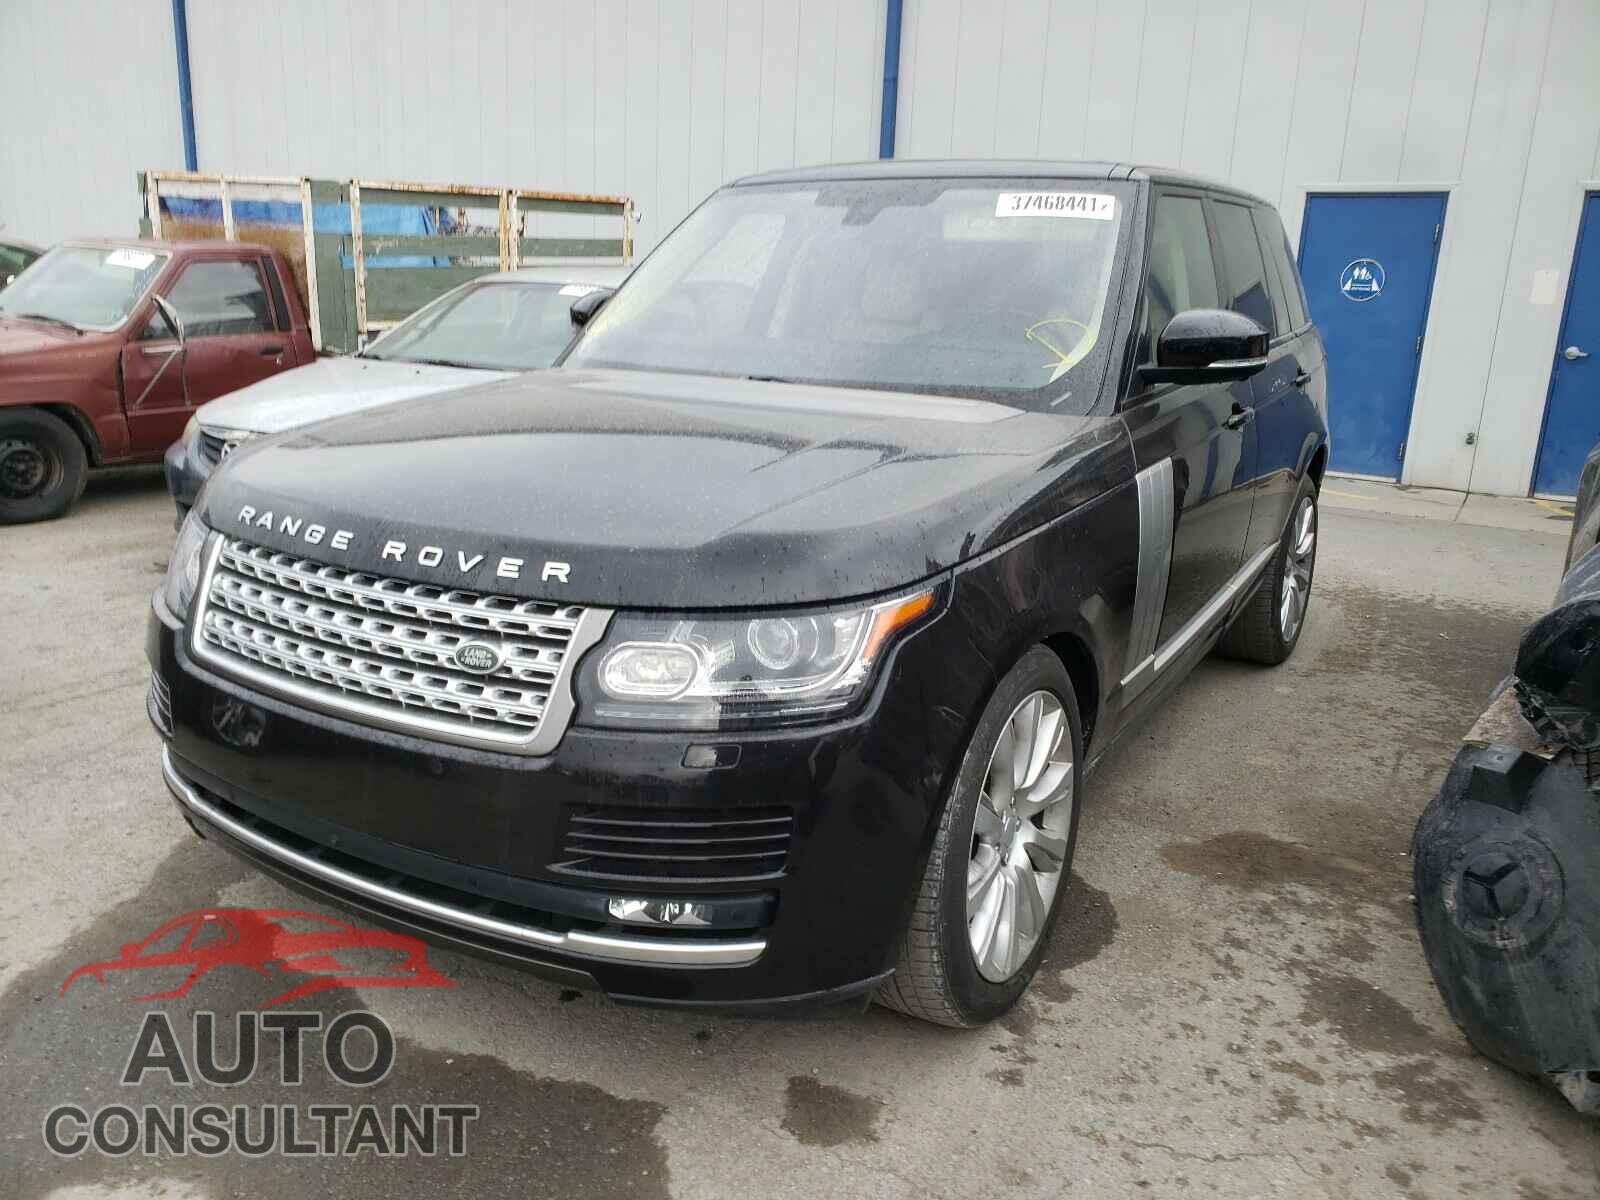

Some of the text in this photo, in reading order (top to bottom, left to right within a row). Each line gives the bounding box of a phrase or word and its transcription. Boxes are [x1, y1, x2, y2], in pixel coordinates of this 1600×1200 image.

[238, 504, 571, 583] RANGE ROVER
[464, 647, 487, 659] LAND
[464, 656, 492, 668] ROVER
